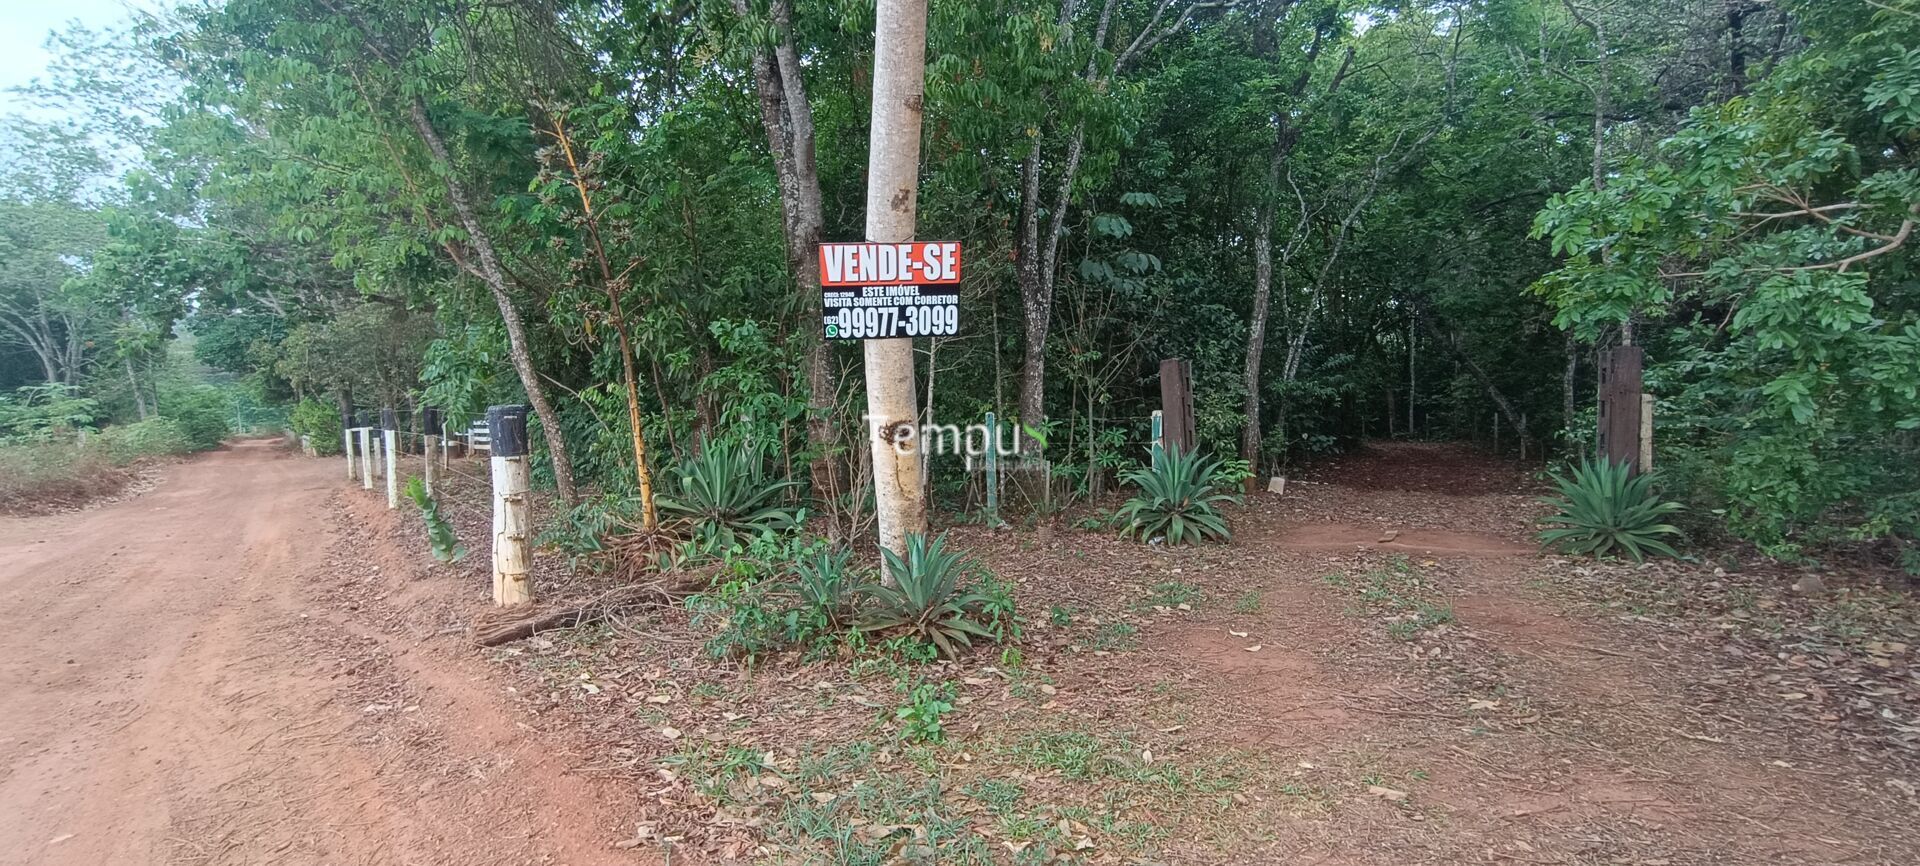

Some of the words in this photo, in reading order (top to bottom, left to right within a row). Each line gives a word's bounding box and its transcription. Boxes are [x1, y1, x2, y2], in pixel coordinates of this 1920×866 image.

[823, 243, 956, 281] VENDE-SE
[824, 297, 852, 307] VISITA
[853, 297, 892, 307] SOMENTE
[893, 295, 913, 306] COM
[914, 295, 958, 305] CORRETOR
[862, 286, 884, 297] ESTE
[885, 284, 920, 297] IMÓVEL
[838, 305, 958, 338] 99977-3099
